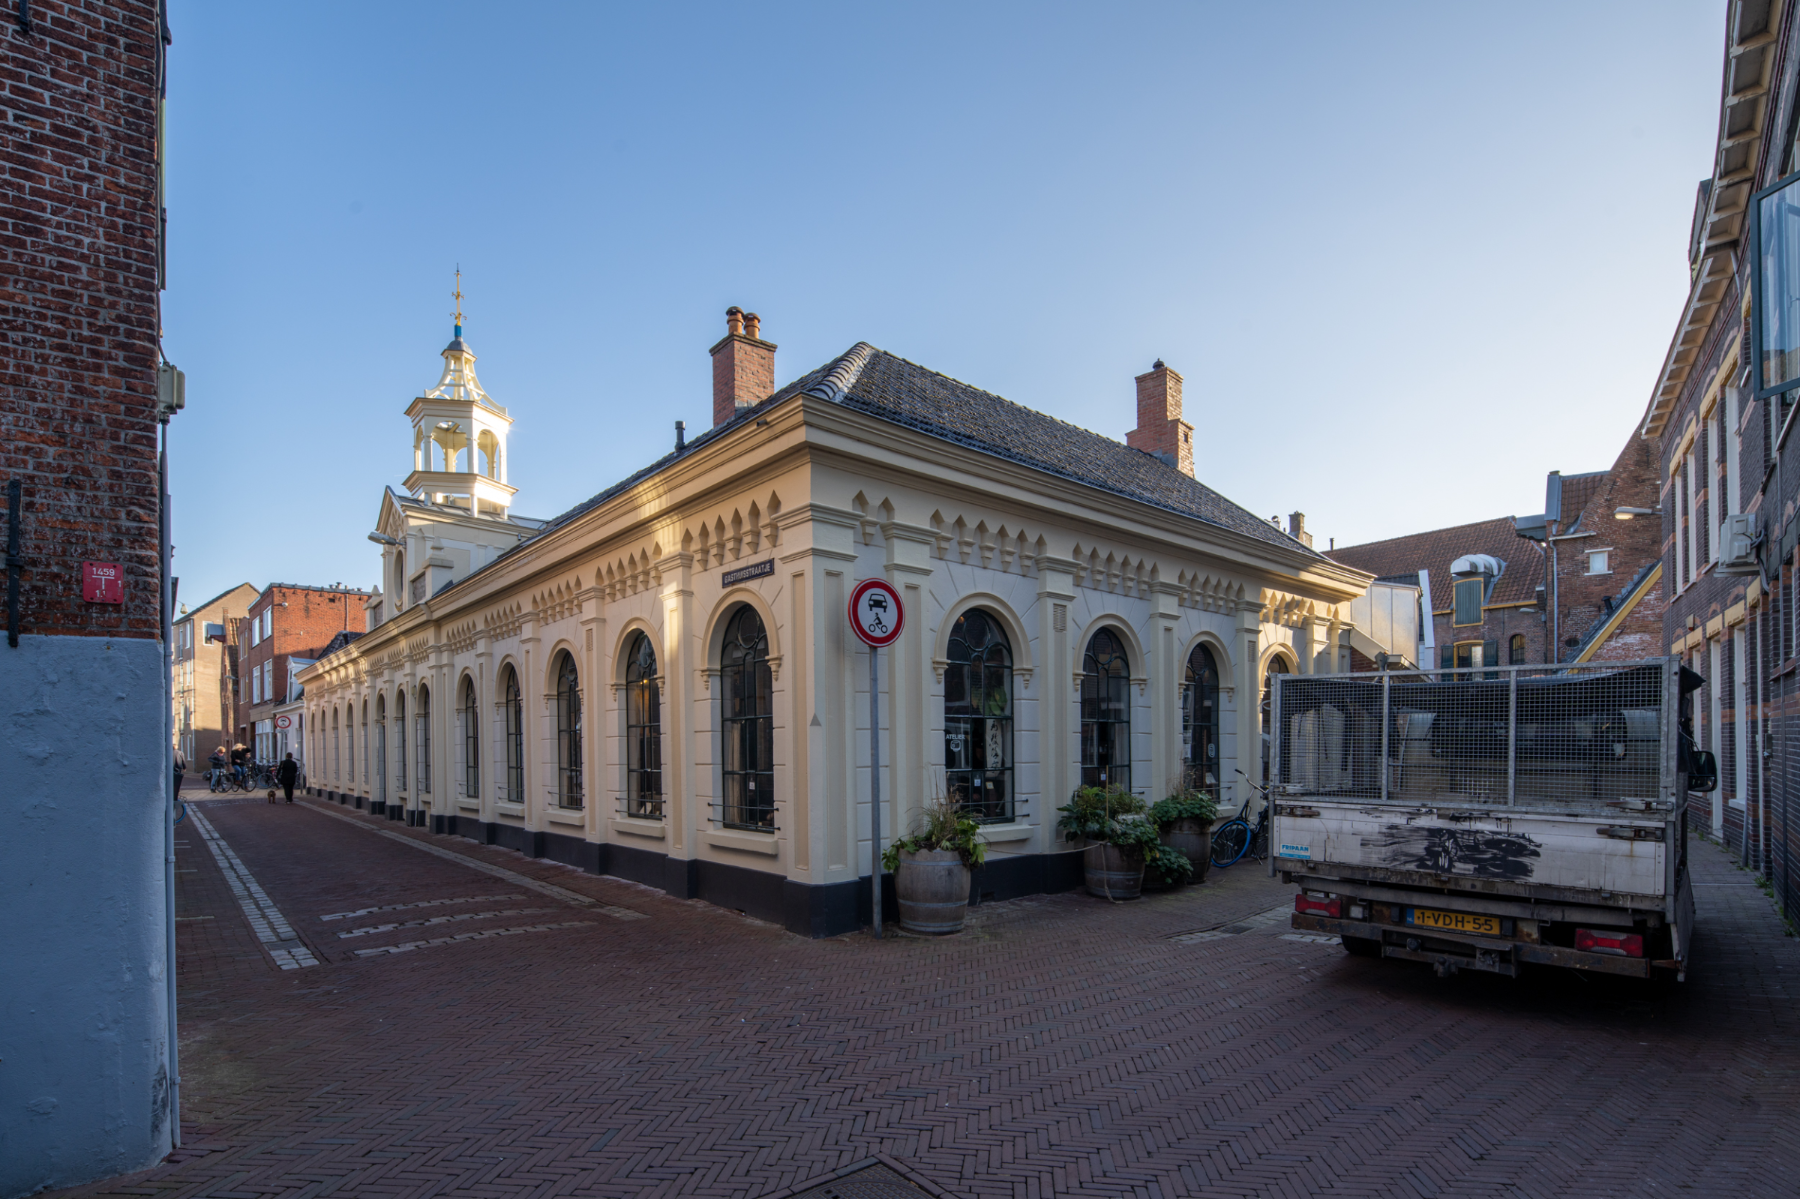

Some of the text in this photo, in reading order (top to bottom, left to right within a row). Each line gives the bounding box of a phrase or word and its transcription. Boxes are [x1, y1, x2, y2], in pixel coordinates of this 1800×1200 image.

[92, 567, 115, 577] 1459
[724, 562, 771, 584] GASTHUISSTRAATJE
[1281, 844, 1310, 852] FRIPAAN
[1420, 911, 1494, 932] 1-VDH-55
